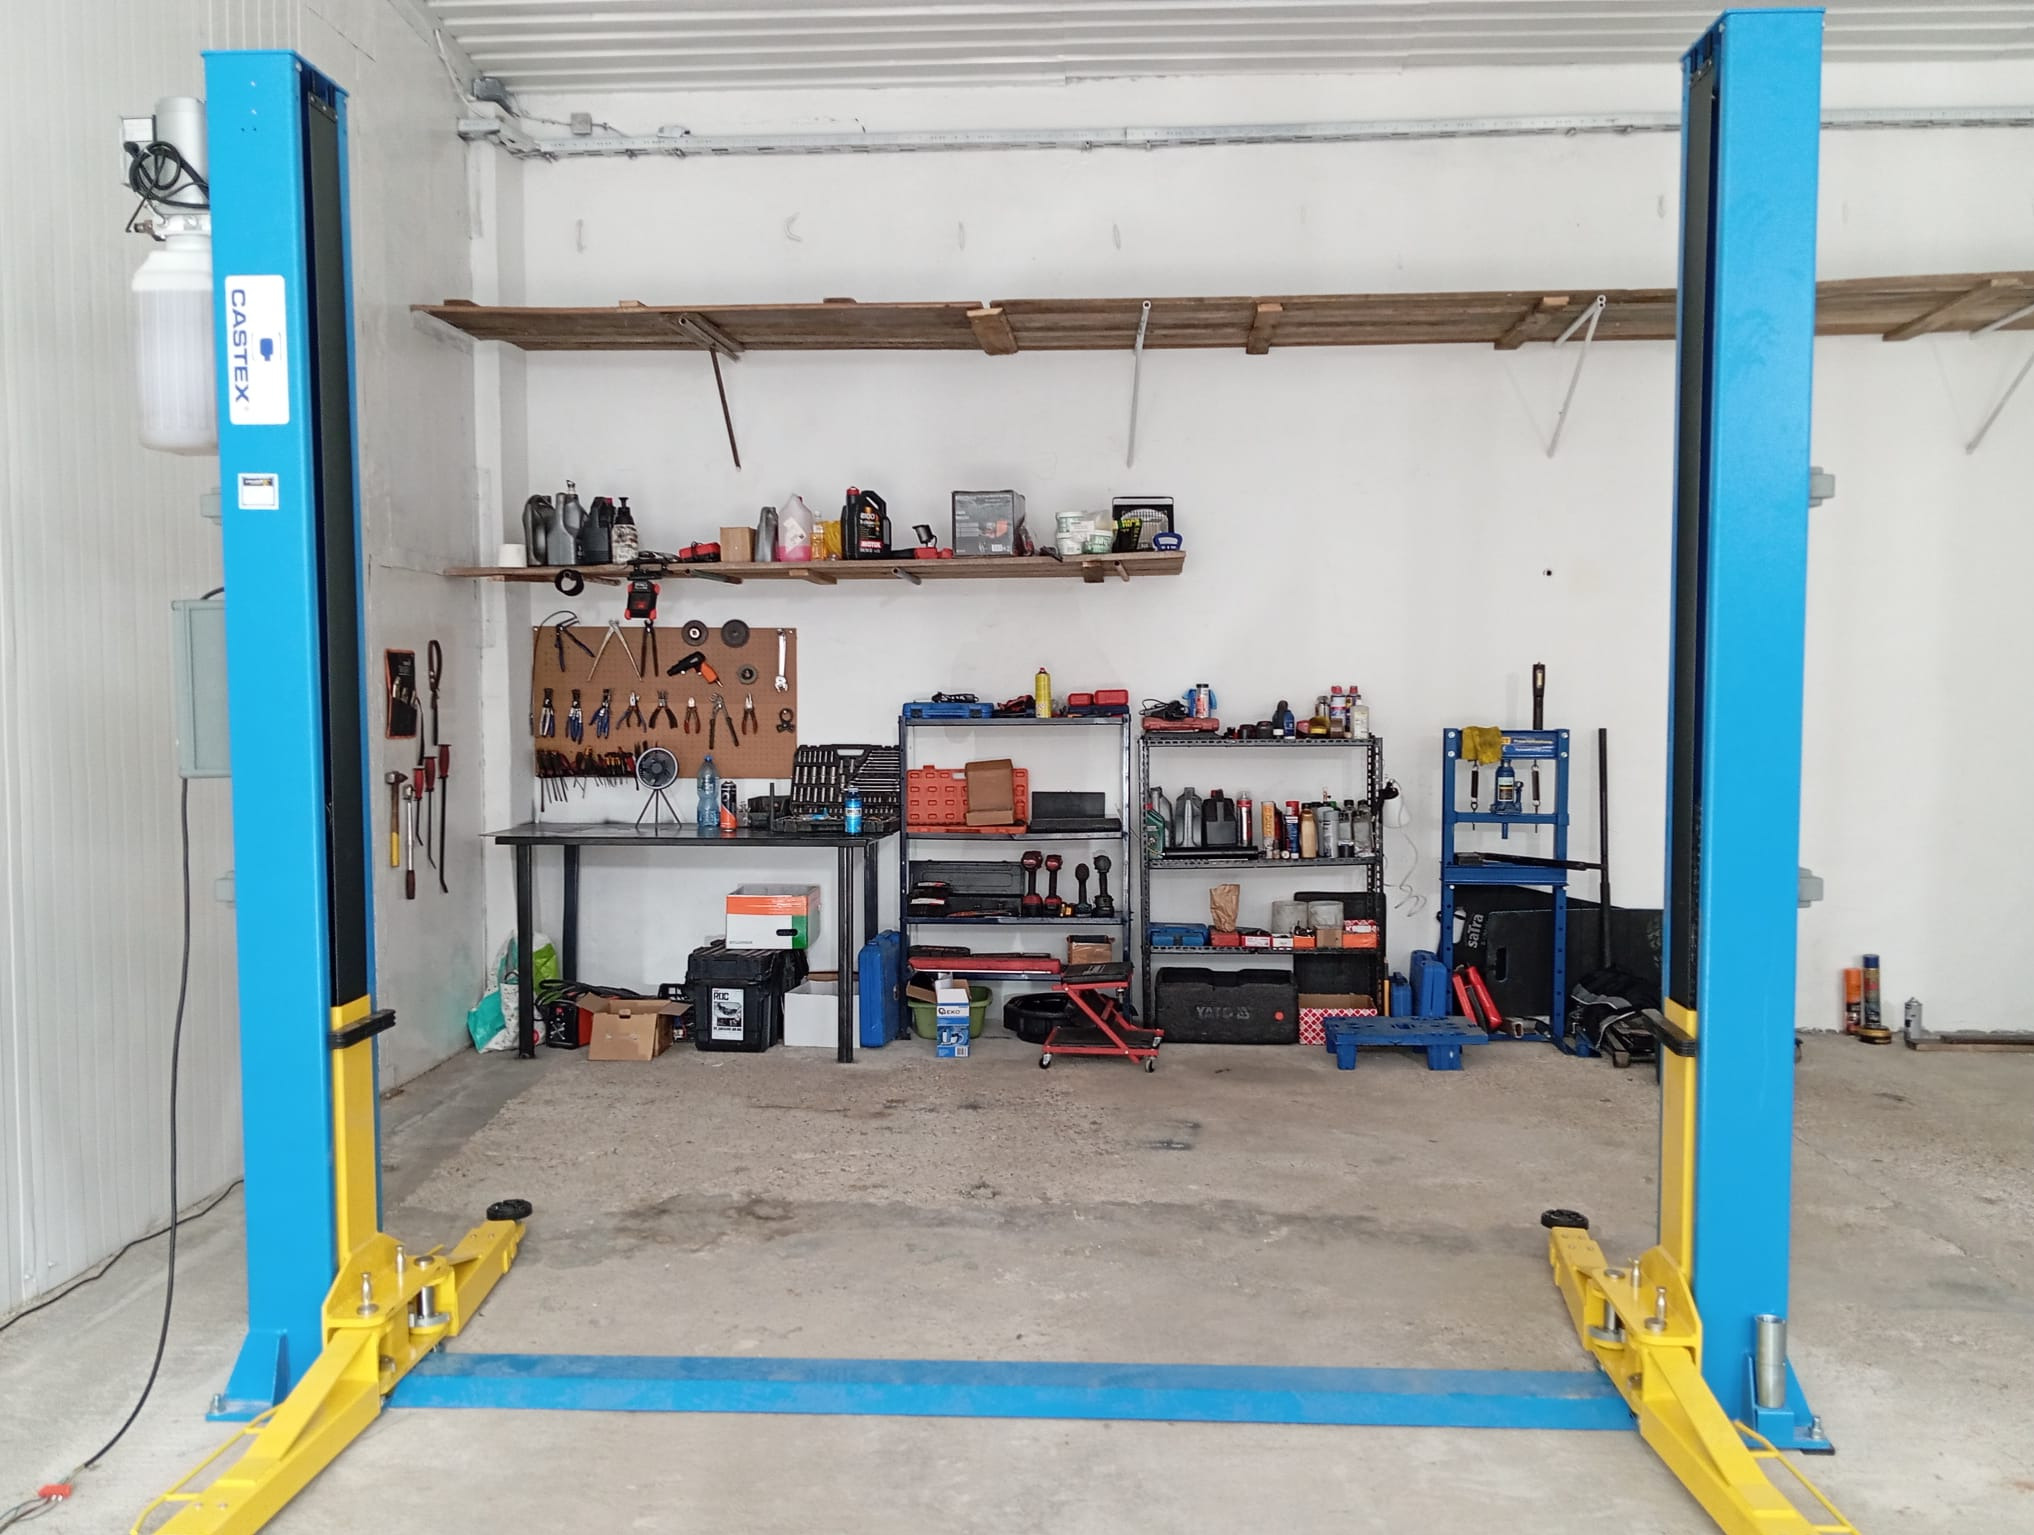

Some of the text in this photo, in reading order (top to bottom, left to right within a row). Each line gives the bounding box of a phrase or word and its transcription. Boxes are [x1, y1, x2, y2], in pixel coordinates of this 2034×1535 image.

[231, 289, 249, 402] CASTEX
[1467, 914, 1484, 948] saTra
[1196, 1006, 1233, 1018] YATO
